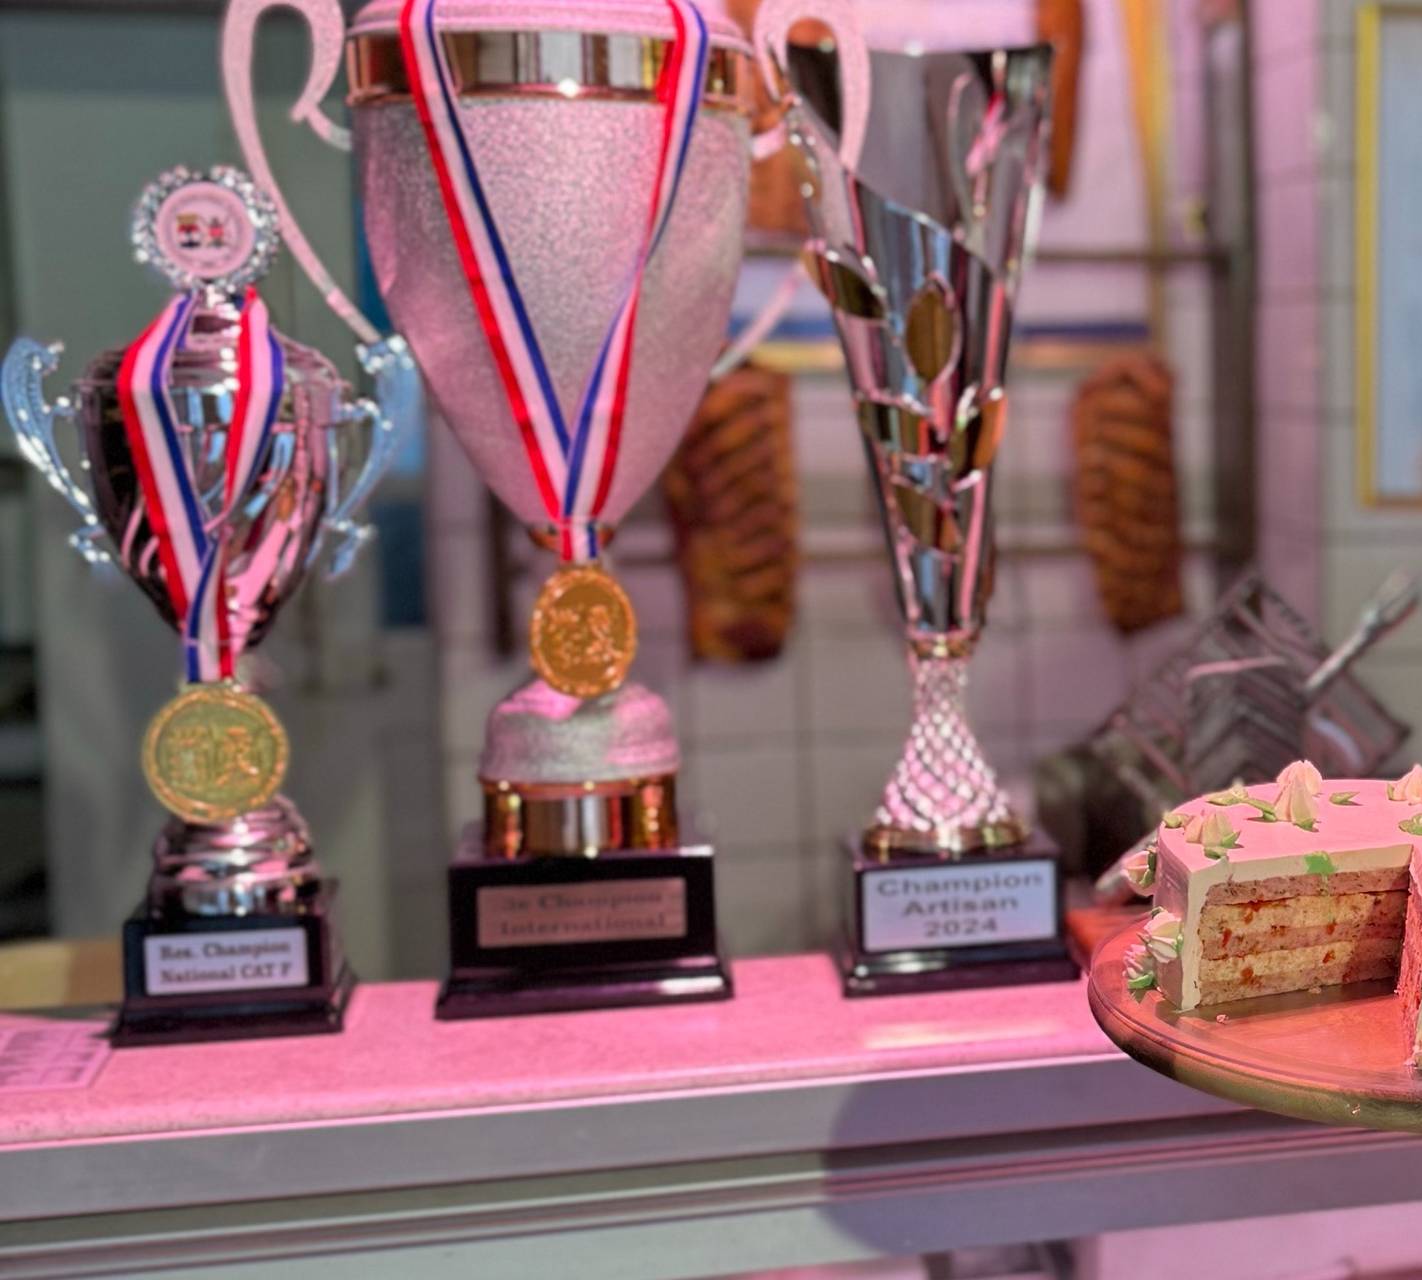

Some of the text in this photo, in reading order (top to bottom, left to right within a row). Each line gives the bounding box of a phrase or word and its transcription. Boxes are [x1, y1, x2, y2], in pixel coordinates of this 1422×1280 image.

[877, 873, 1043, 896] Champion
[538, 892, 662, 911] Champion
[903, 897, 1018, 916] Artisan
[501, 912, 665, 935] International
[925, 917, 998, 937] 2024
[203, 939, 291, 959] Champion
[161, 964, 236, 983] National
[241, 962, 274, 979] CAT
